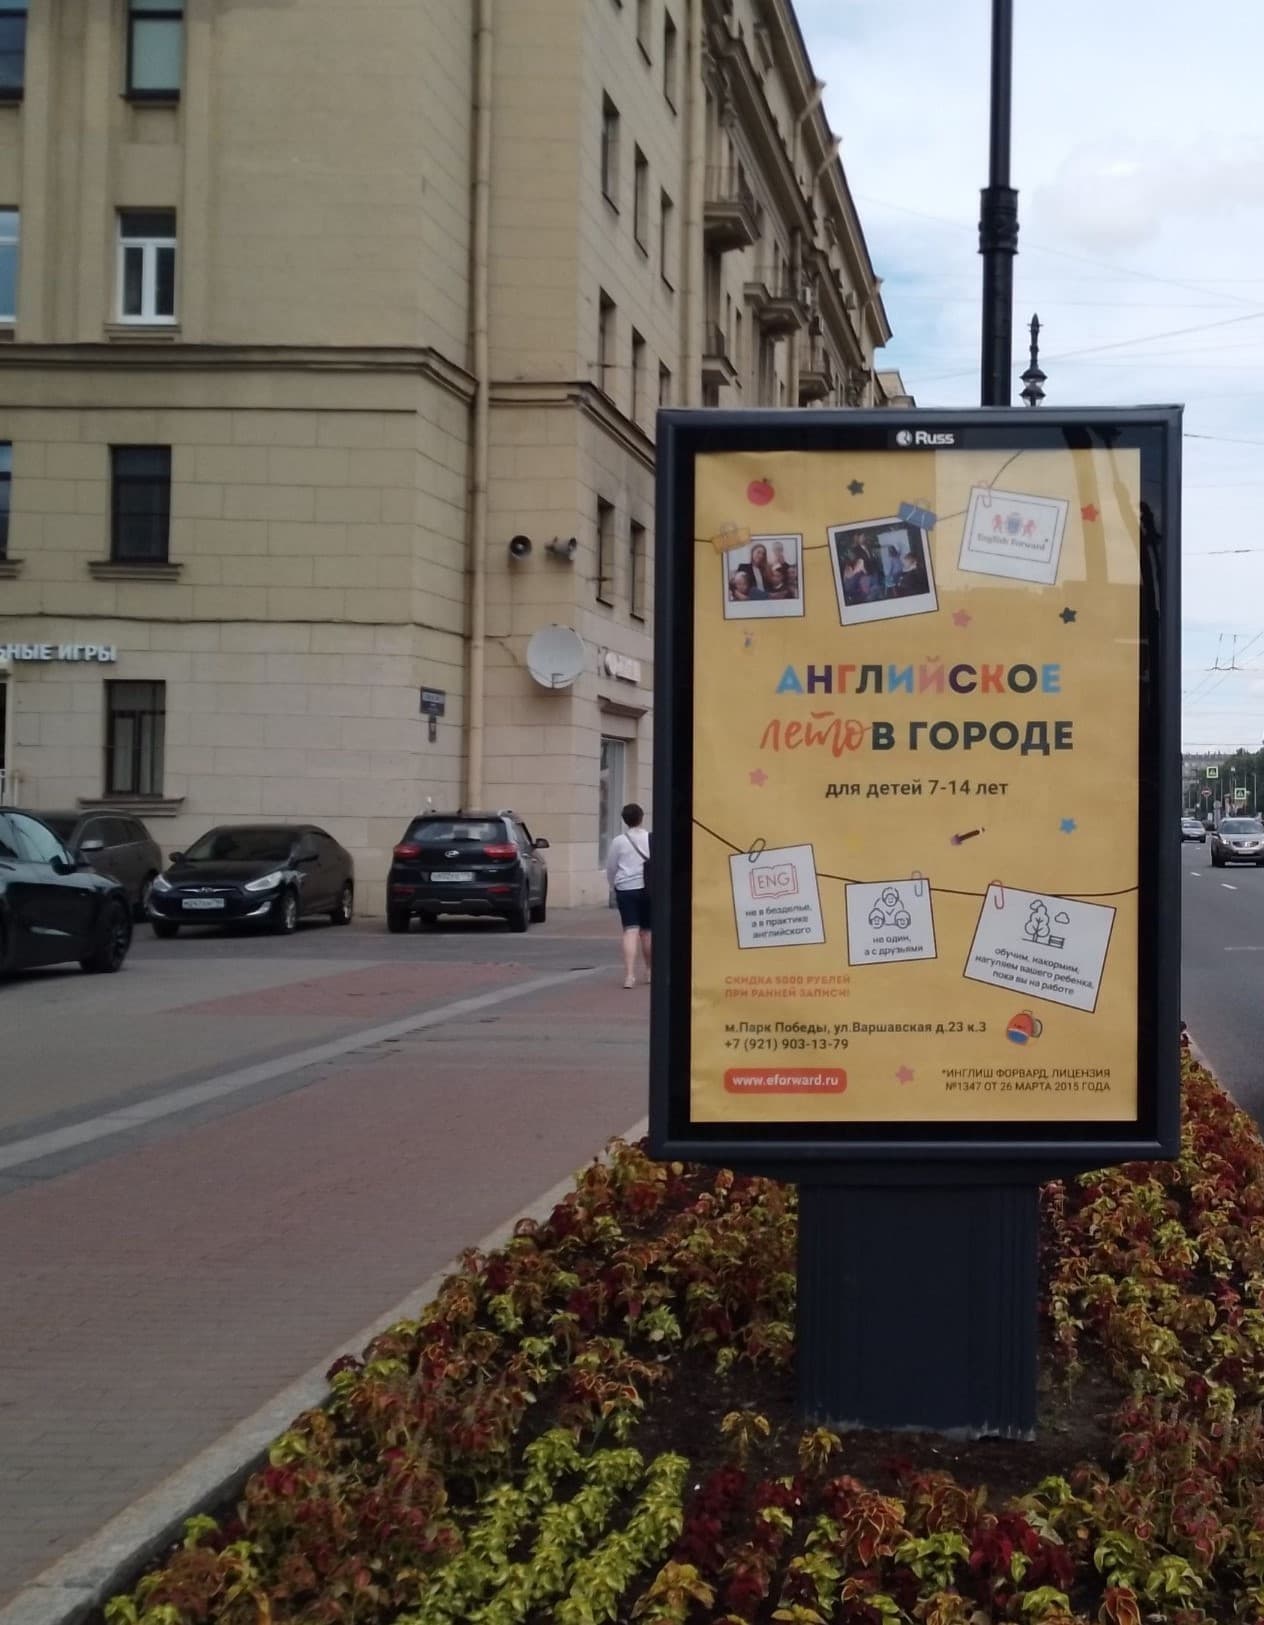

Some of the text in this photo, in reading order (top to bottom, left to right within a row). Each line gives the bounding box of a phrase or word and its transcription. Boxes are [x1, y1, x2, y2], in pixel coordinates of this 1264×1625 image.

[915, 430, 955, 445] Russ
[58, 643, 118, 662] ИГРЫ
[774, 655, 1062, 694] АНГЛИЙСКОЕ
[871, 721, 895, 751] В
[909, 720, 1074, 756] ГОРОДЕ
[825, 779, 1009, 799] для детей 7-14 лет
[757, 873, 791, 889] ENG
[752, 926, 812, 939] английского
[878, 944, 924, 958] друзьями
[974, 954, 1018, 972] нагуляем
[1019, 964, 1053, 979] вашего
[724, 974, 850, 986] СКИДКА 5000 РУБЛЕЙ
[992, 970, 1015, 982] пока
[1028, 978, 1040, 987] на
[1041, 981, 1075, 996] работе
[724, 988, 748, 998] ПРИ
[751, 986, 796, 998] РАННЕЙ
[724, 1021, 987, 1036] м.Парк Победы, ул.Варшавская д.23 к.3
[724, 1039, 849, 1052] +7 (921) 903-13-79
[732, 1075, 839, 1086] www.eforward.ru
[1052, 1068, 1111, 1079] ЛИЦЕНЗИЯ
[945, 1081, 1111, 1092] №1347 ОТ 26 МАРТА 2015 ГОДА
